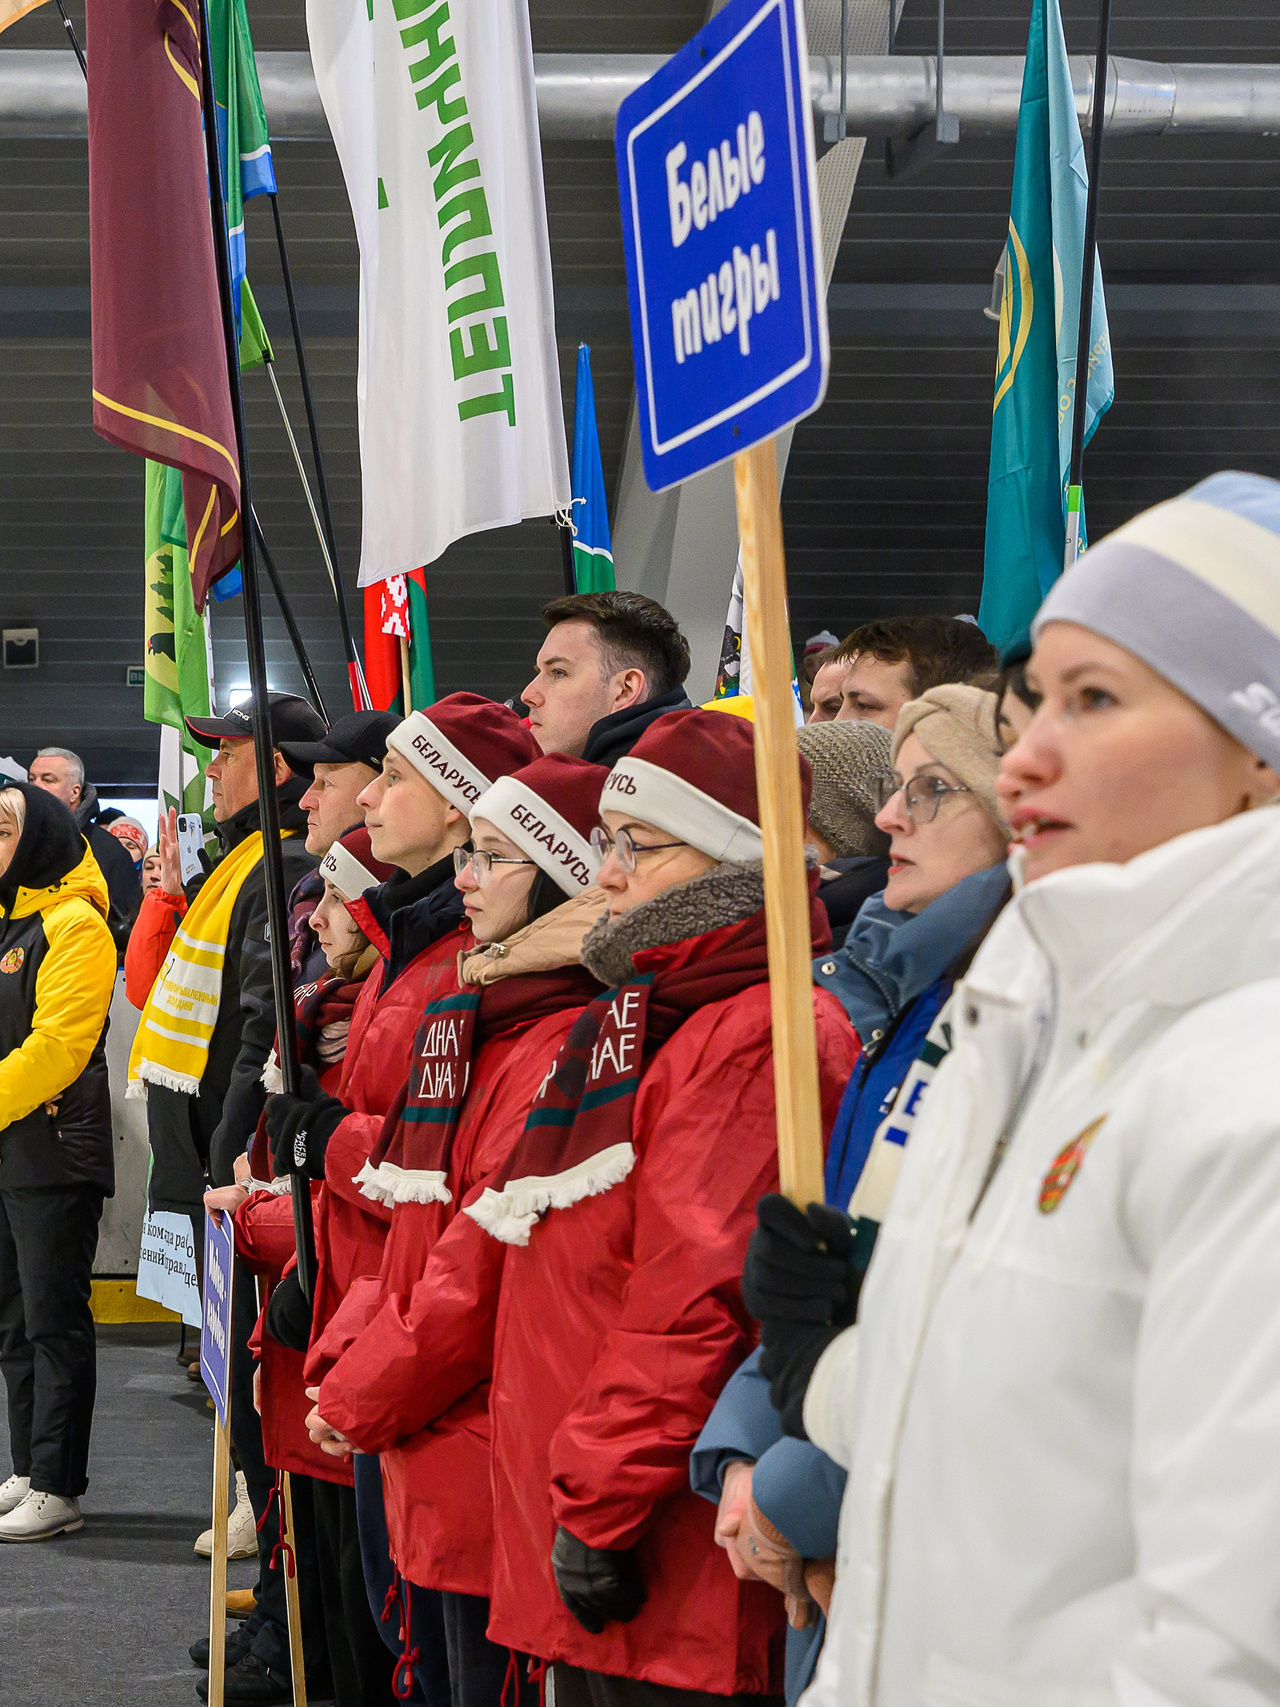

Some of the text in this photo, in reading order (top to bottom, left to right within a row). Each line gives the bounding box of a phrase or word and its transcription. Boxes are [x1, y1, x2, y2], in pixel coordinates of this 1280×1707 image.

[665, 110, 766, 248] Белые
[671, 228, 781, 364] тигры
[510, 803, 590, 886] БЕЛАРУСЬ
